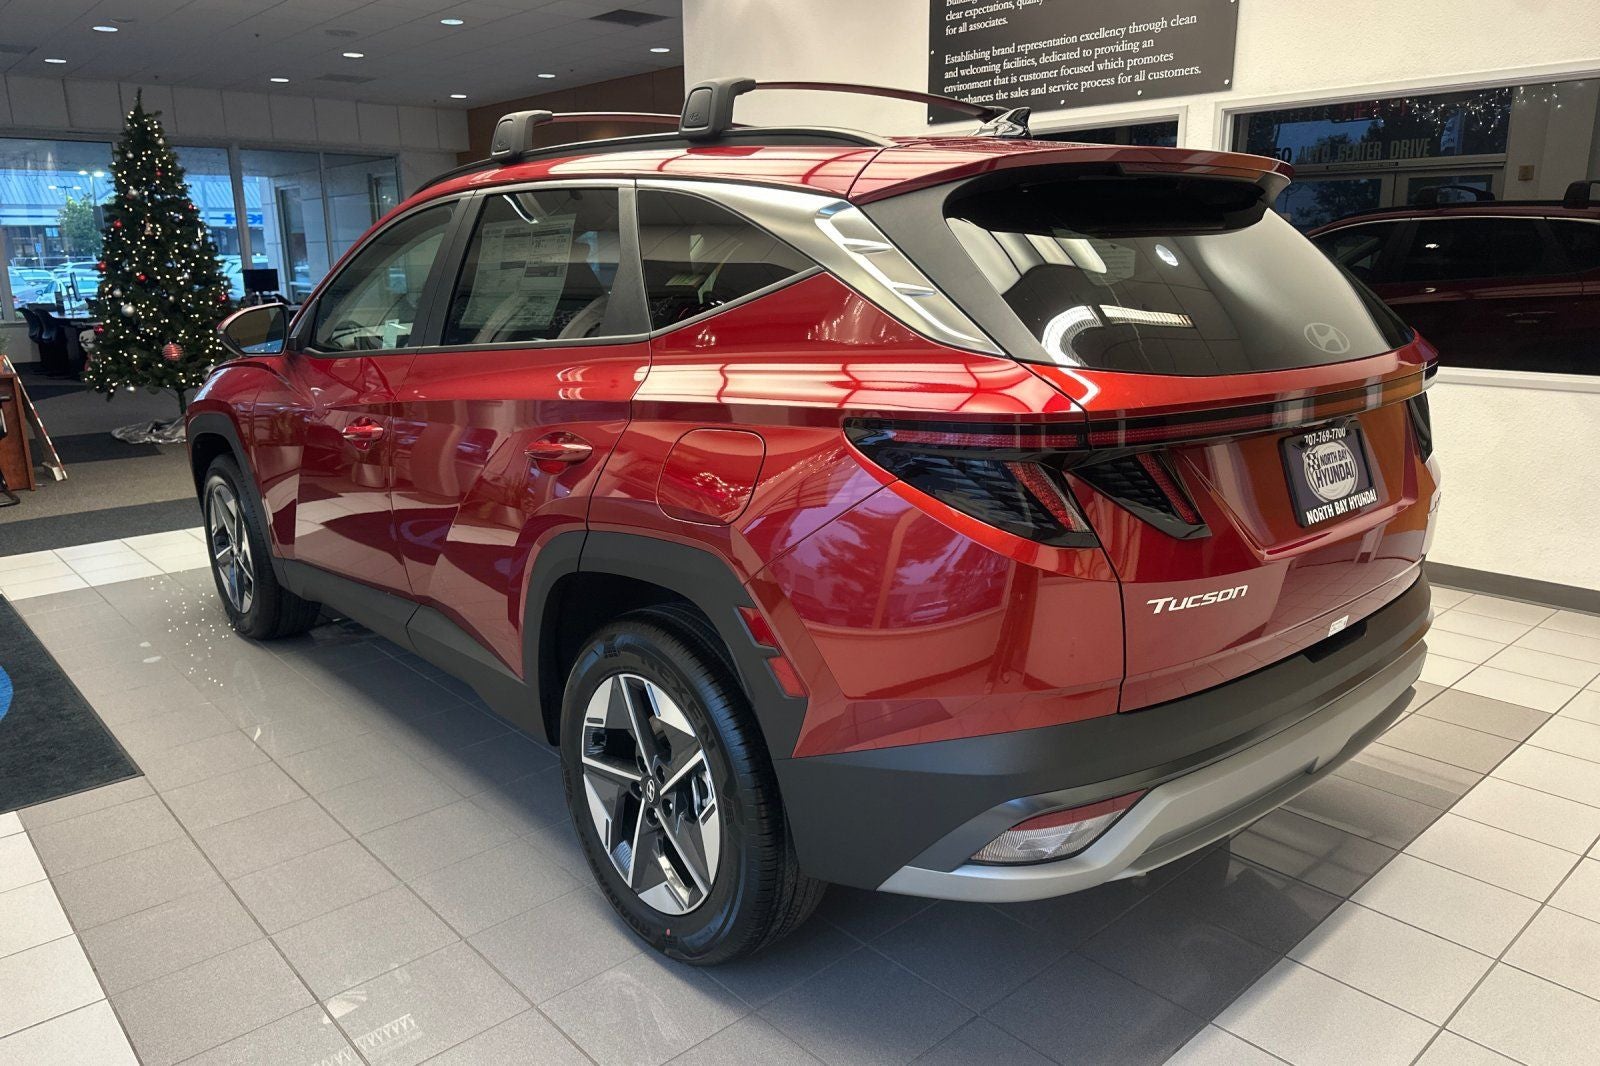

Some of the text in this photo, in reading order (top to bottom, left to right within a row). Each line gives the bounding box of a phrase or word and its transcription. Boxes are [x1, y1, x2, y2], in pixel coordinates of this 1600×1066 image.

[946, 11, 963, 21] clear
[965, 0, 1015, 19] expectations,
[945, 17, 1009, 36] for all associates.
[945, 14, 1197, 65] Establishing brand representation excellency through clean
[944, 38, 1155, 79] and welcoming facilities, dedicated to providing an
[944, 51, 1174, 93] environment that is customer focused which promotes
[995, 89, 1009, 100] the
[1010, 87, 1029, 99] sales
[1030, 83, 1046, 95] and
[1048, 80, 1079, 93] service
[1080, 77, 1115, 93] process
[1117, 73, 1133, 85] for
[1134, 70, 1146, 82] all
[1147, 66, 1202, 80] customers.
[1337, 141, 1383, 161] CENTER
[1390, 138, 1431, 159] DRIVE
[1315, 460, 1355, 489] HYUNDAI
[1320, 451, 1338, 467] NORTH
[1306, 489, 1378, 525] NORTH BAY HYUNDAI
